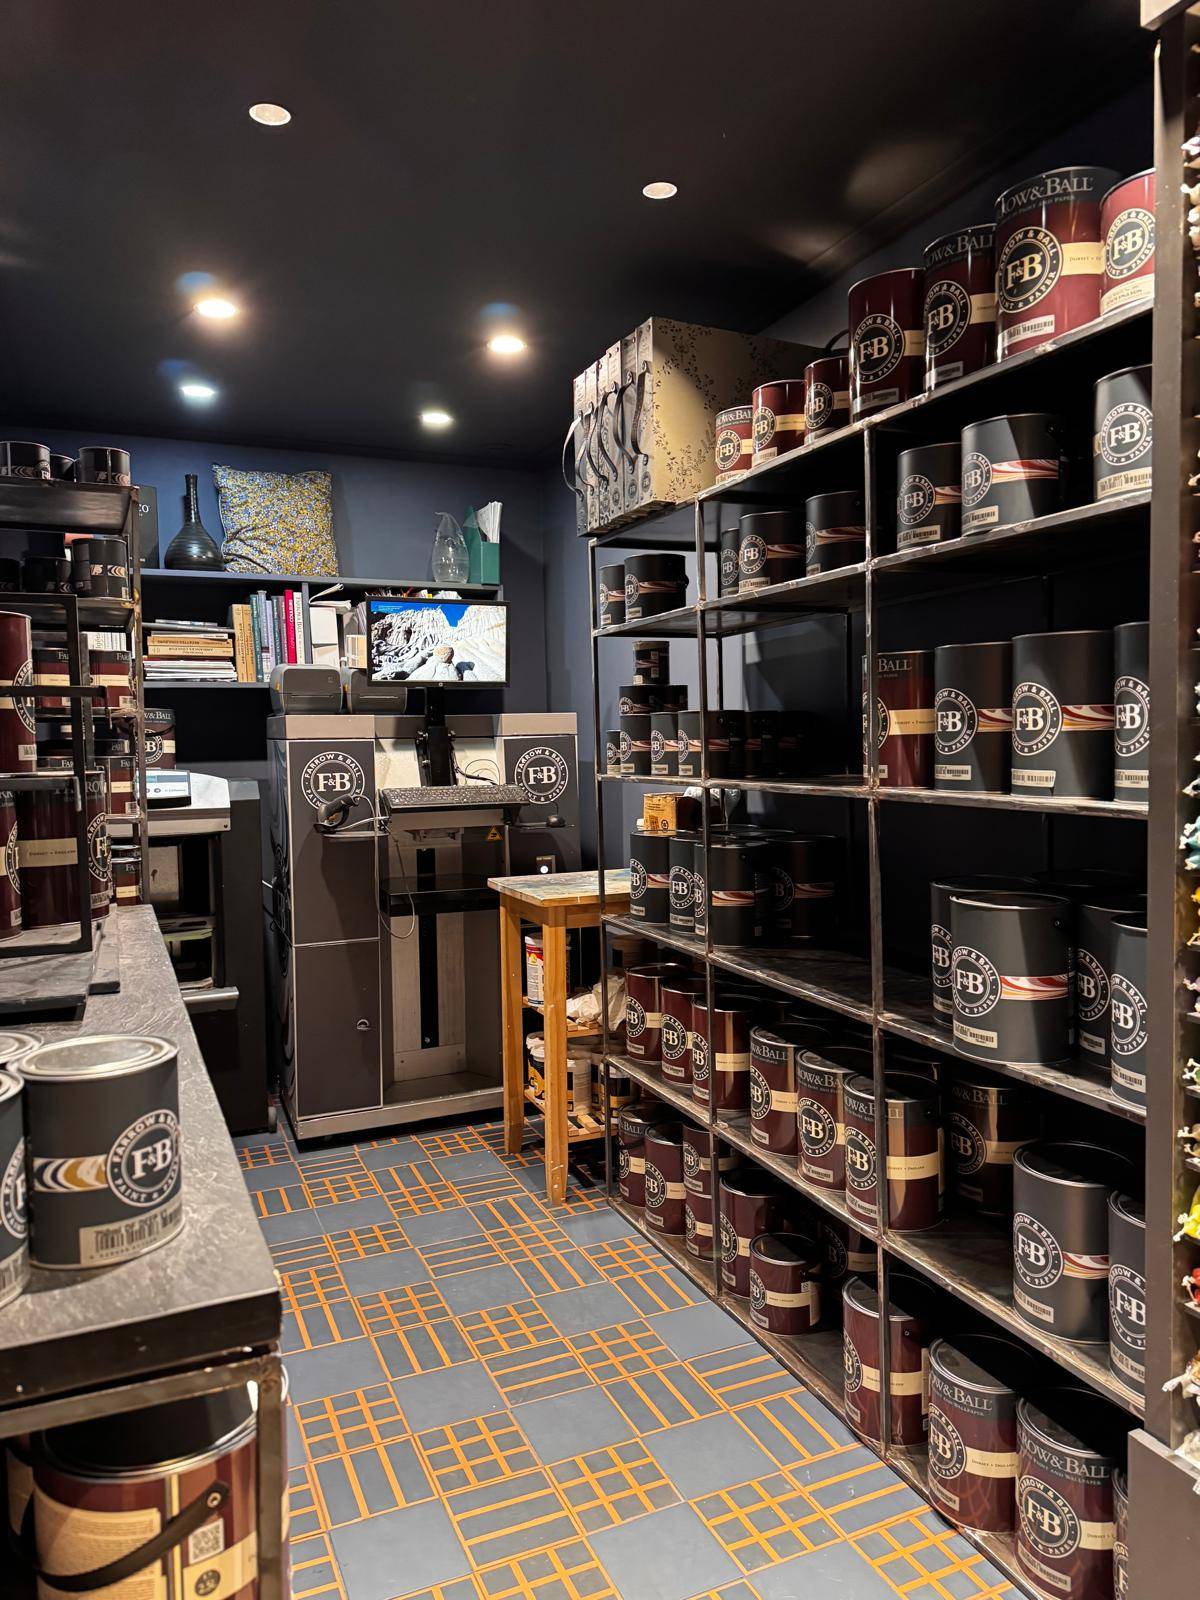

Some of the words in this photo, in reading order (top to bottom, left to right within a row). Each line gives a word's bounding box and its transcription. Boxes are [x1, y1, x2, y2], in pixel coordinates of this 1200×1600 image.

[1137, 213, 1155, 231] BALL
[1027, 230, 1034, 238] &
[1037, 232, 1058, 257] BALL
[1112, 229, 1143, 260] F&B
[1132, 242, 1154, 269] PAPER
[1006, 253, 1043, 289] F&B
[949, 284, 968, 306] BALL
[1029, 271, 1057, 303] PAPER
[883, 320, 901, 339] BALL
[927, 303, 955, 335] F&B
[943, 320, 966, 349] PAPER
[858, 336, 889, 364] F&B
[878, 352, 900, 376] PAPER
[1135, 407, 1152, 425] BALL
[754, 420, 768, 436] F&B
[1109, 422, 1141, 448] F&B
[719, 444, 735, 458] F&B
[1130, 436, 1152, 459] PAPER
[978, 457, 988, 471] BALL
[921, 478, 932, 493] BALL
[964, 469, 981, 490] F&B
[974, 481, 989, 501] PAPER
[903, 491, 924, 510] F&B
[916, 502, 932, 520] PAPER
[743, 547, 759, 562] F&B
[957, 694, 973, 717] BALL
[1031, 686, 1038, 694] &
[1039, 690, 1058, 714] BALL
[937, 710, 962, 732] F&B
[1015, 707, 1044, 731] F&B
[1115, 703, 1141, 729] F&B
[952, 729, 973, 750] PAPER
[1032, 727, 1056, 751] PAPER
[304, 754, 335, 778] FARROW
[345, 758, 361, 778] BALL
[517, 749, 542, 773] FARROW
[551, 753, 565, 771] BALL
[316, 772, 351, 792] F&B
[527, 765, 557, 785] F&B
[549, 780, 565, 798] PAPER
[672, 880, 688, 895] F&B
[970, 952, 977, 960] &
[978, 958, 996, 982] BALL
[1091, 962, 1107, 986] BALL
[956, 968, 984, 995] F&B
[973, 994, 996, 1013] PAPER
[1087, 999, 1106, 1018] PAPER
[1121, 981, 1127, 989] &
[1129, 988, 1147, 1015] BALL
[1112, 998, 1134, 1029] F&B
[663, 1028, 679, 1045] F&B
[1123, 1030, 1147, 1051] PAPER
[758, 1075, 769, 1095] BALL
[802, 1114, 824, 1139] F&B
[820, 1109, 833, 1129] BALL
[112, 1114, 156, 1163] FARROW
[158, 1113, 166, 1123] &
[814, 1138, 833, 1156] PAPER
[858, 1132, 865, 1140] &
[131, 1138, 172, 1180] F&B
[847, 1144, 869, 1172] F&B
[114, 1178, 146, 1202] PAINT
[1018, 1232, 1046, 1267] F&B
[1040, 1230, 1059, 1256] BALL
[1035, 1269, 1058, 1285] PAPER
[1134, 1277, 1142, 1286] &
[1115, 1287, 1146, 1326] F&B
[930, 1424, 952, 1459] F&B
[947, 1424, 963, 1450] BALL
[941, 1463, 961, 1477] PAPER
[1065, 1473, 1102, 1486] WALLPAPER
[1026, 1496, 1062, 1537] F&B
[1049, 1490, 1055, 1498] &
[1056, 1498, 1076, 1528] BALL
[1048, 1539, 1074, 1556] PAPER
